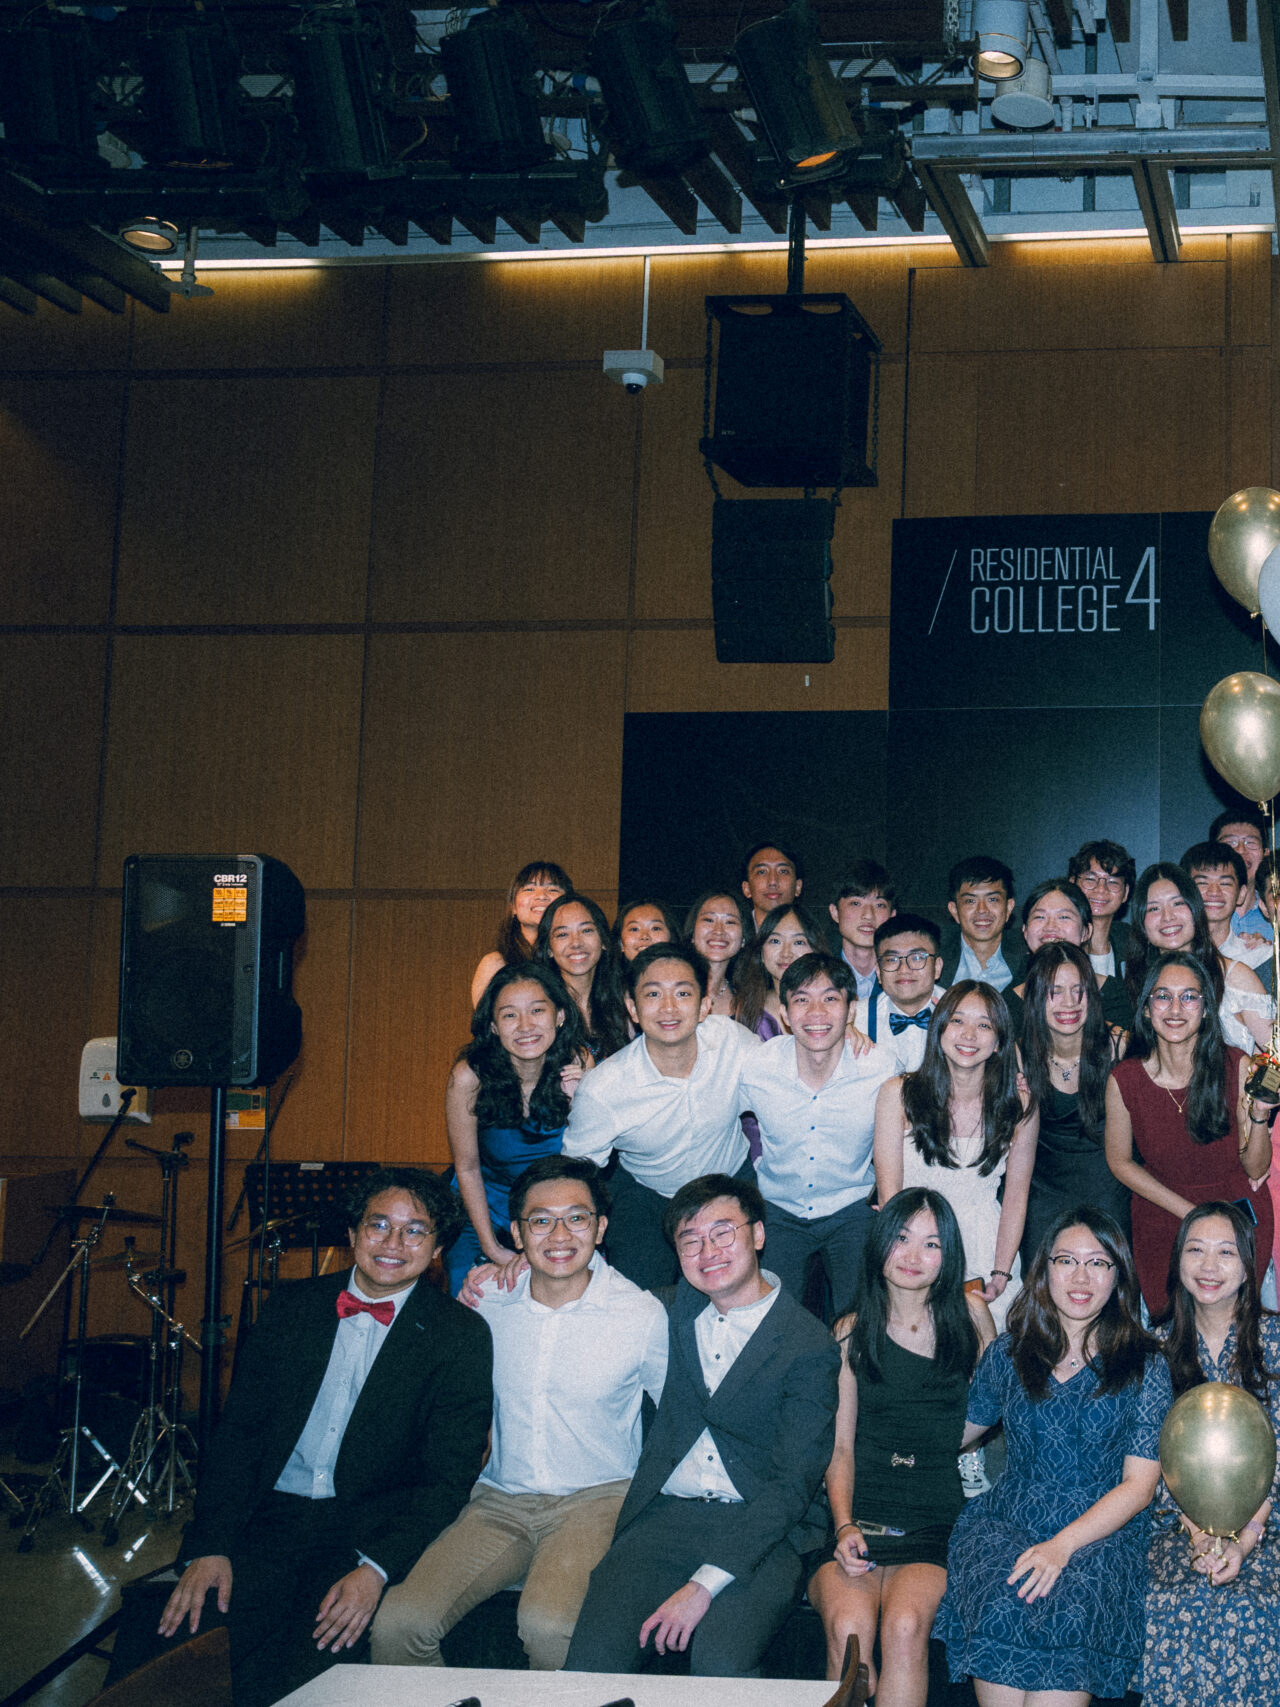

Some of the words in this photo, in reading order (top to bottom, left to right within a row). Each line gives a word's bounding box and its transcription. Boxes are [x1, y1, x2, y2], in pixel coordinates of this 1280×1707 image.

[970, 546, 1122, 582] RESIDENTIAL
[970, 585, 1121, 633] COLLEGE
[1124, 546, 1161, 631] 4
[213, 874, 248, 883] CBR12
